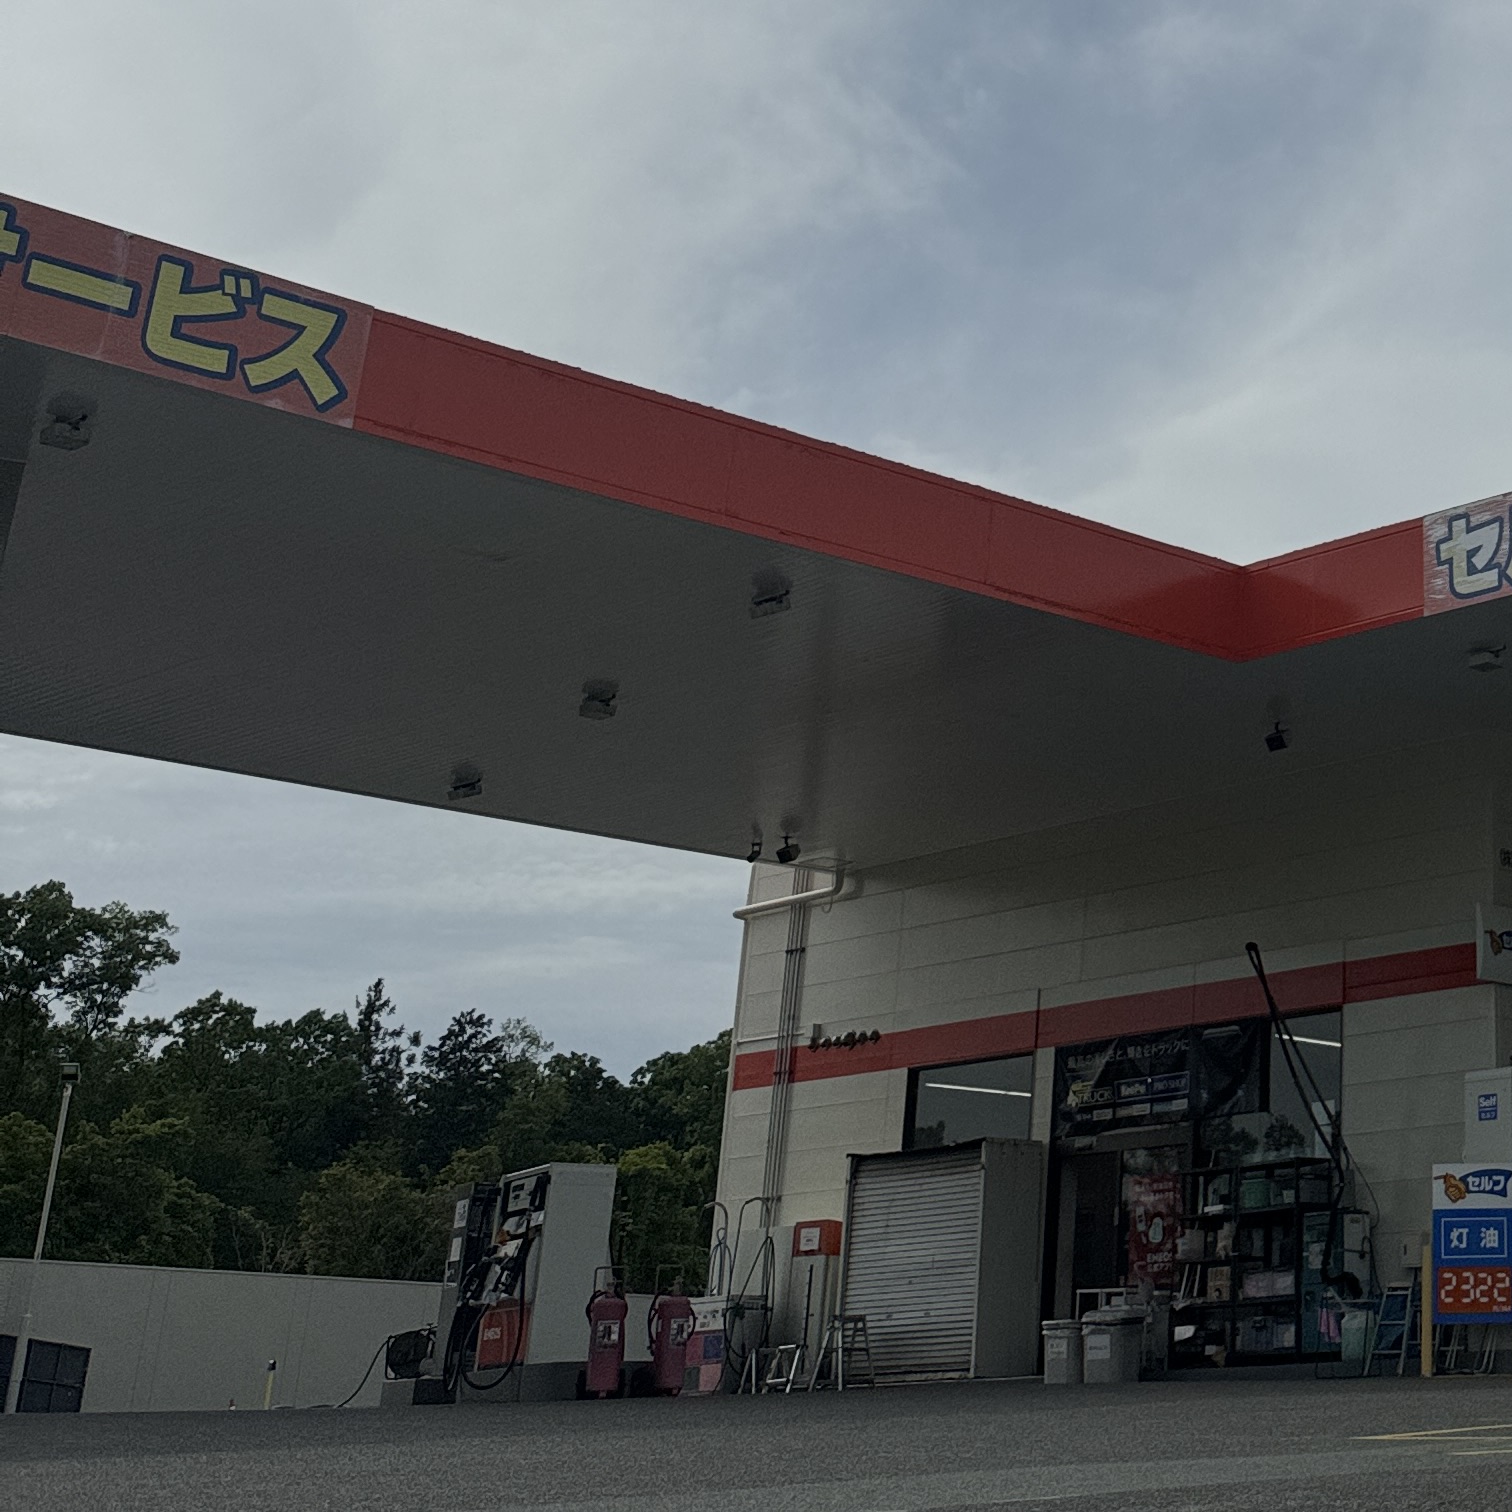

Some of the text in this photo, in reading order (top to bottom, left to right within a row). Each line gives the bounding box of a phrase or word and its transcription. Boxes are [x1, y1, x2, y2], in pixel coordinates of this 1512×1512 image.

[0, 202, 347, 412] ービス
[1479, 1095, 1497, 1108] Self
[1466, 1174, 1506, 1192] セルフ
[1449, 1226, 1499, 1249] 灯油
[1440, 1272, 1510, 1303] 2322
